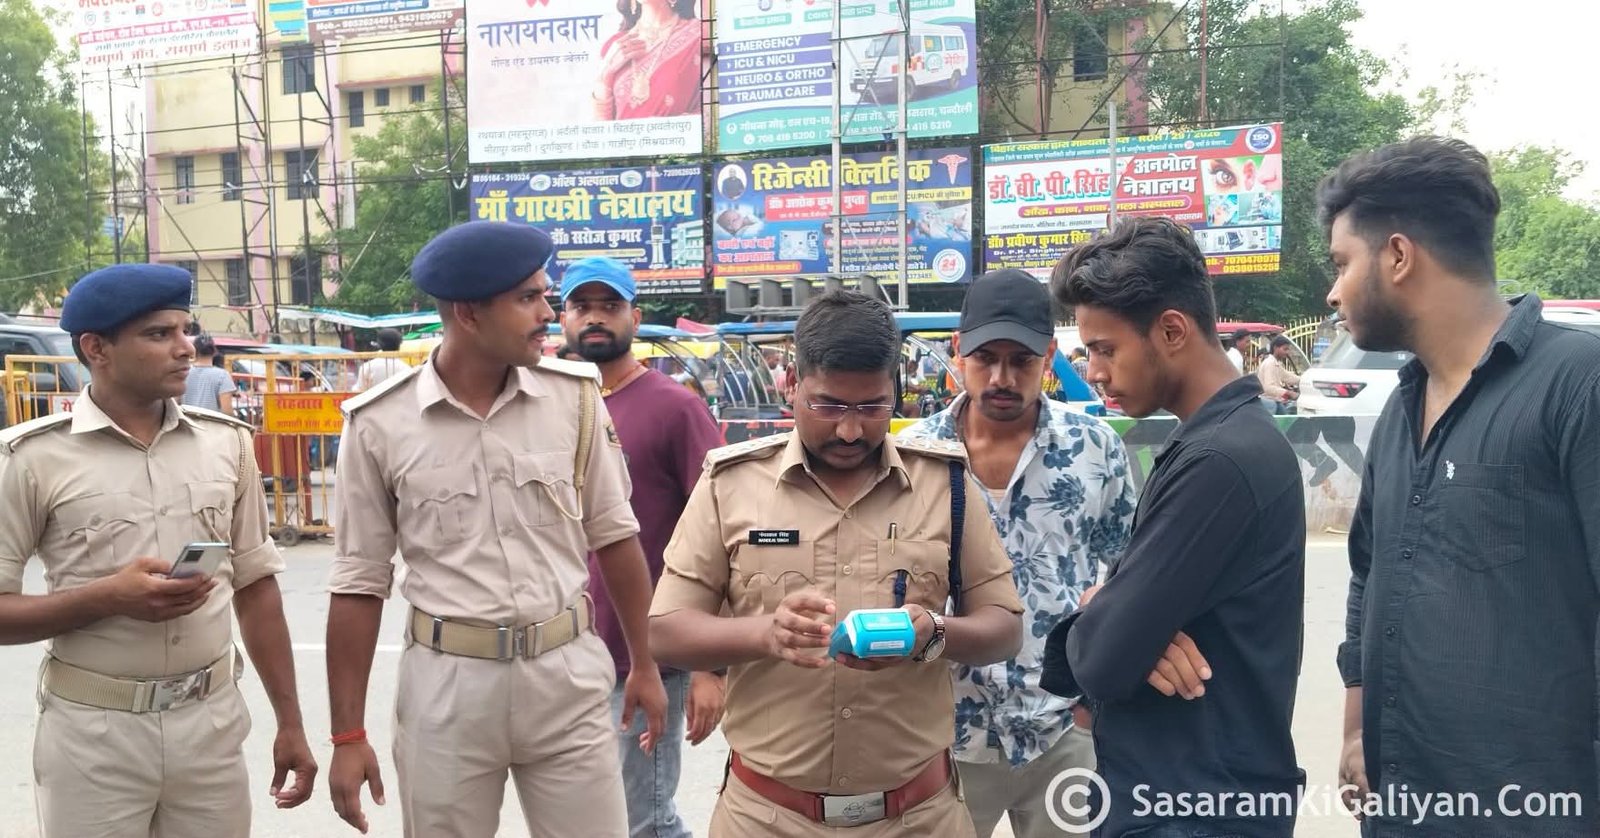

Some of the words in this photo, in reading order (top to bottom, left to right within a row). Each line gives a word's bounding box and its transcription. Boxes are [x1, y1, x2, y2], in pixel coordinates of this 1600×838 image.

[733, 36, 801, 52] EMERGENCY
[734, 57, 755, 69] ICU
[757, 56, 765, 67] &
[767, 54, 795, 66] NICU
[734, 73, 773, 86] NEURO
[775, 72, 783, 82] &
[785, 68, 826, 80] ORTHO
[735, 89, 783, 102] TRAUMA
[785, 86, 815, 97] CARE
[1134, 153, 1197, 174] अनमोल
[577, 174, 619, 186] अस्पताल
[1122, 176, 1197, 197] नेत्रालय
[514, 188, 594, 222] गायत्री
[598, 187, 695, 220] नेत्रालय
[571, 227, 606, 244] सरोज
[607, 229, 642, 248] कुमार
[1038, 233, 1069, 249] कुमार
[942, 258, 956, 267] 24
